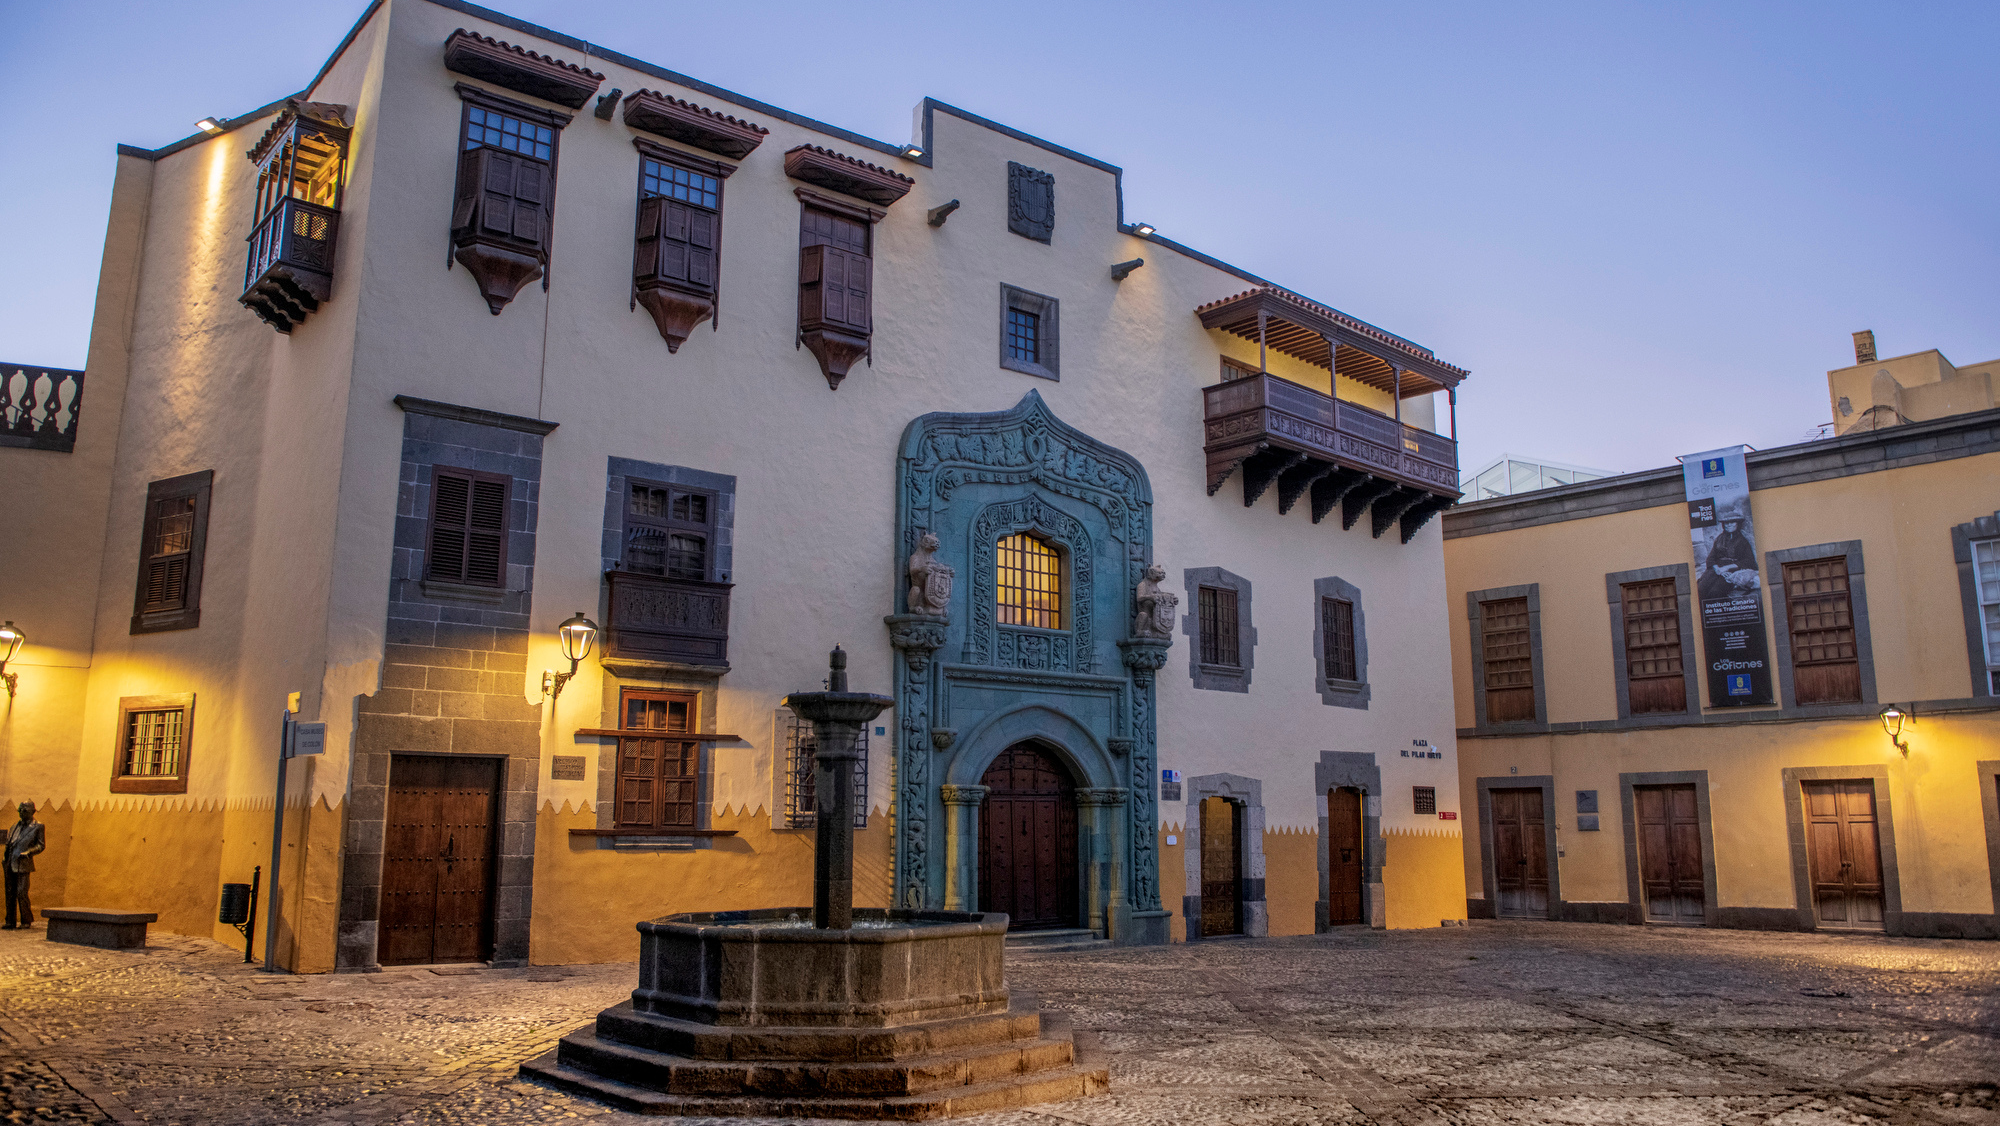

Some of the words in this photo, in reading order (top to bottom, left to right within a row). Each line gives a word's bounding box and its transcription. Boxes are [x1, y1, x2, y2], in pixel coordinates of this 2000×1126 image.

[1705, 601, 1731, 609] Instituto
[1731, 598, 1755, 606] Canario
[1723, 604, 1757, 612] Tradiciones
